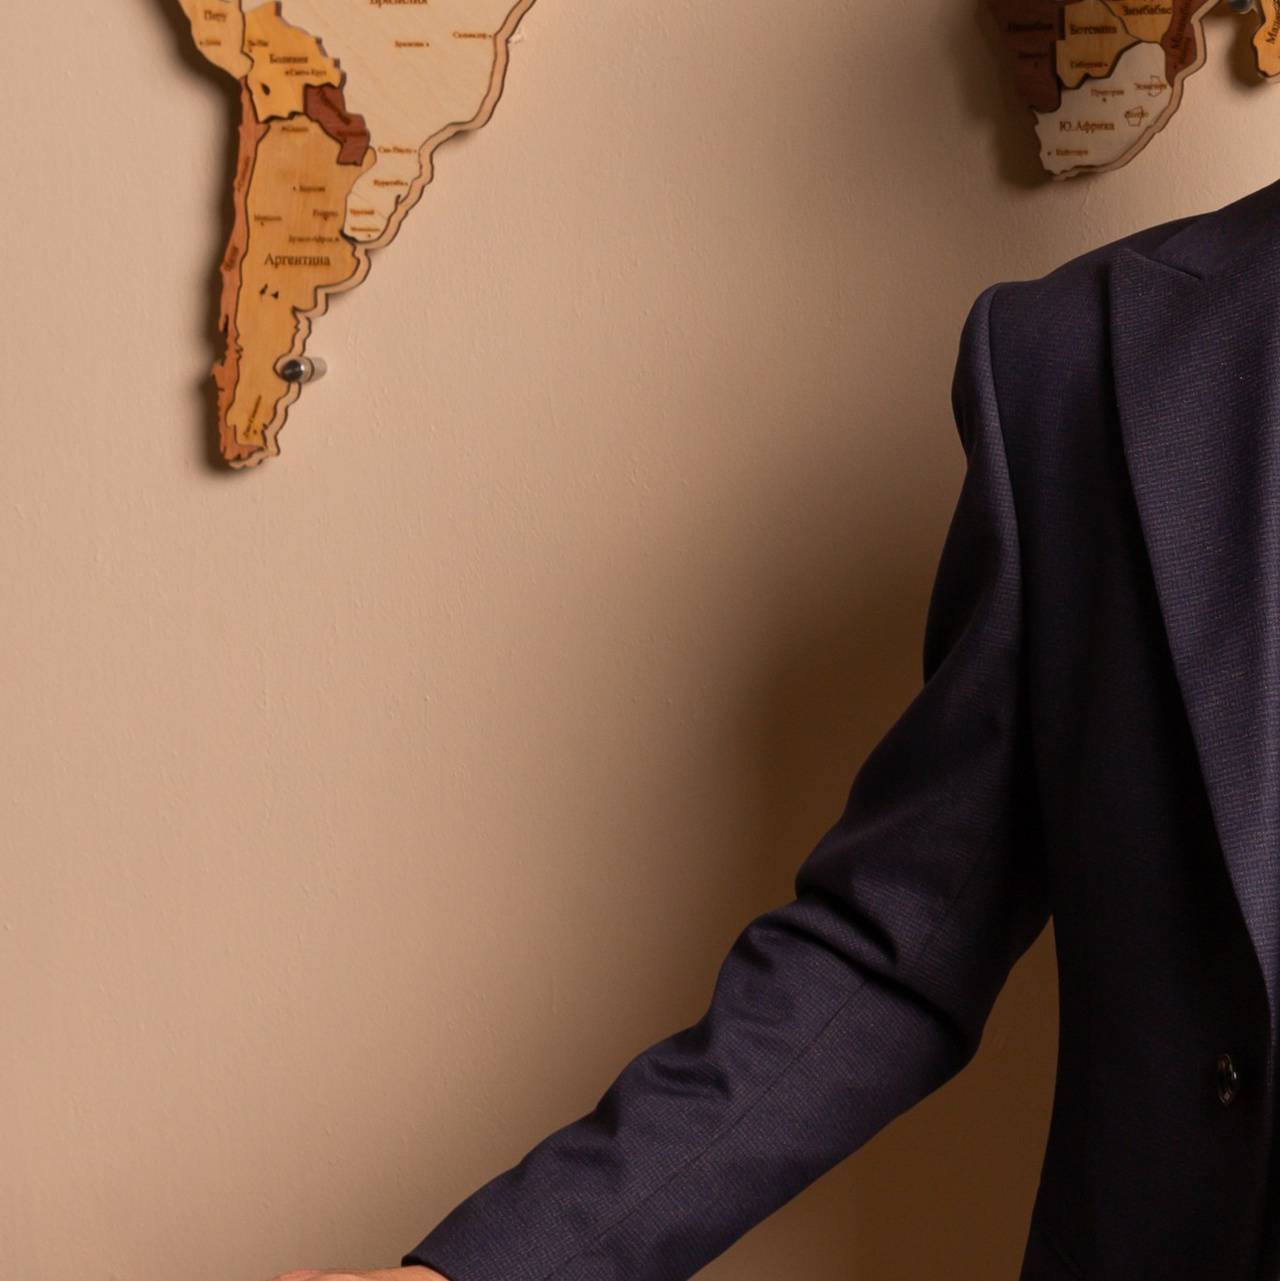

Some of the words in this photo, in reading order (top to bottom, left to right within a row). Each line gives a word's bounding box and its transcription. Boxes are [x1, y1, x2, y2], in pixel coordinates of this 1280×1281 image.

[1122, 4, 1172, 17] Зимбабве
[1070, 22, 1117, 36] Ботсвана
[264, 253, 330, 269] Аргентина
